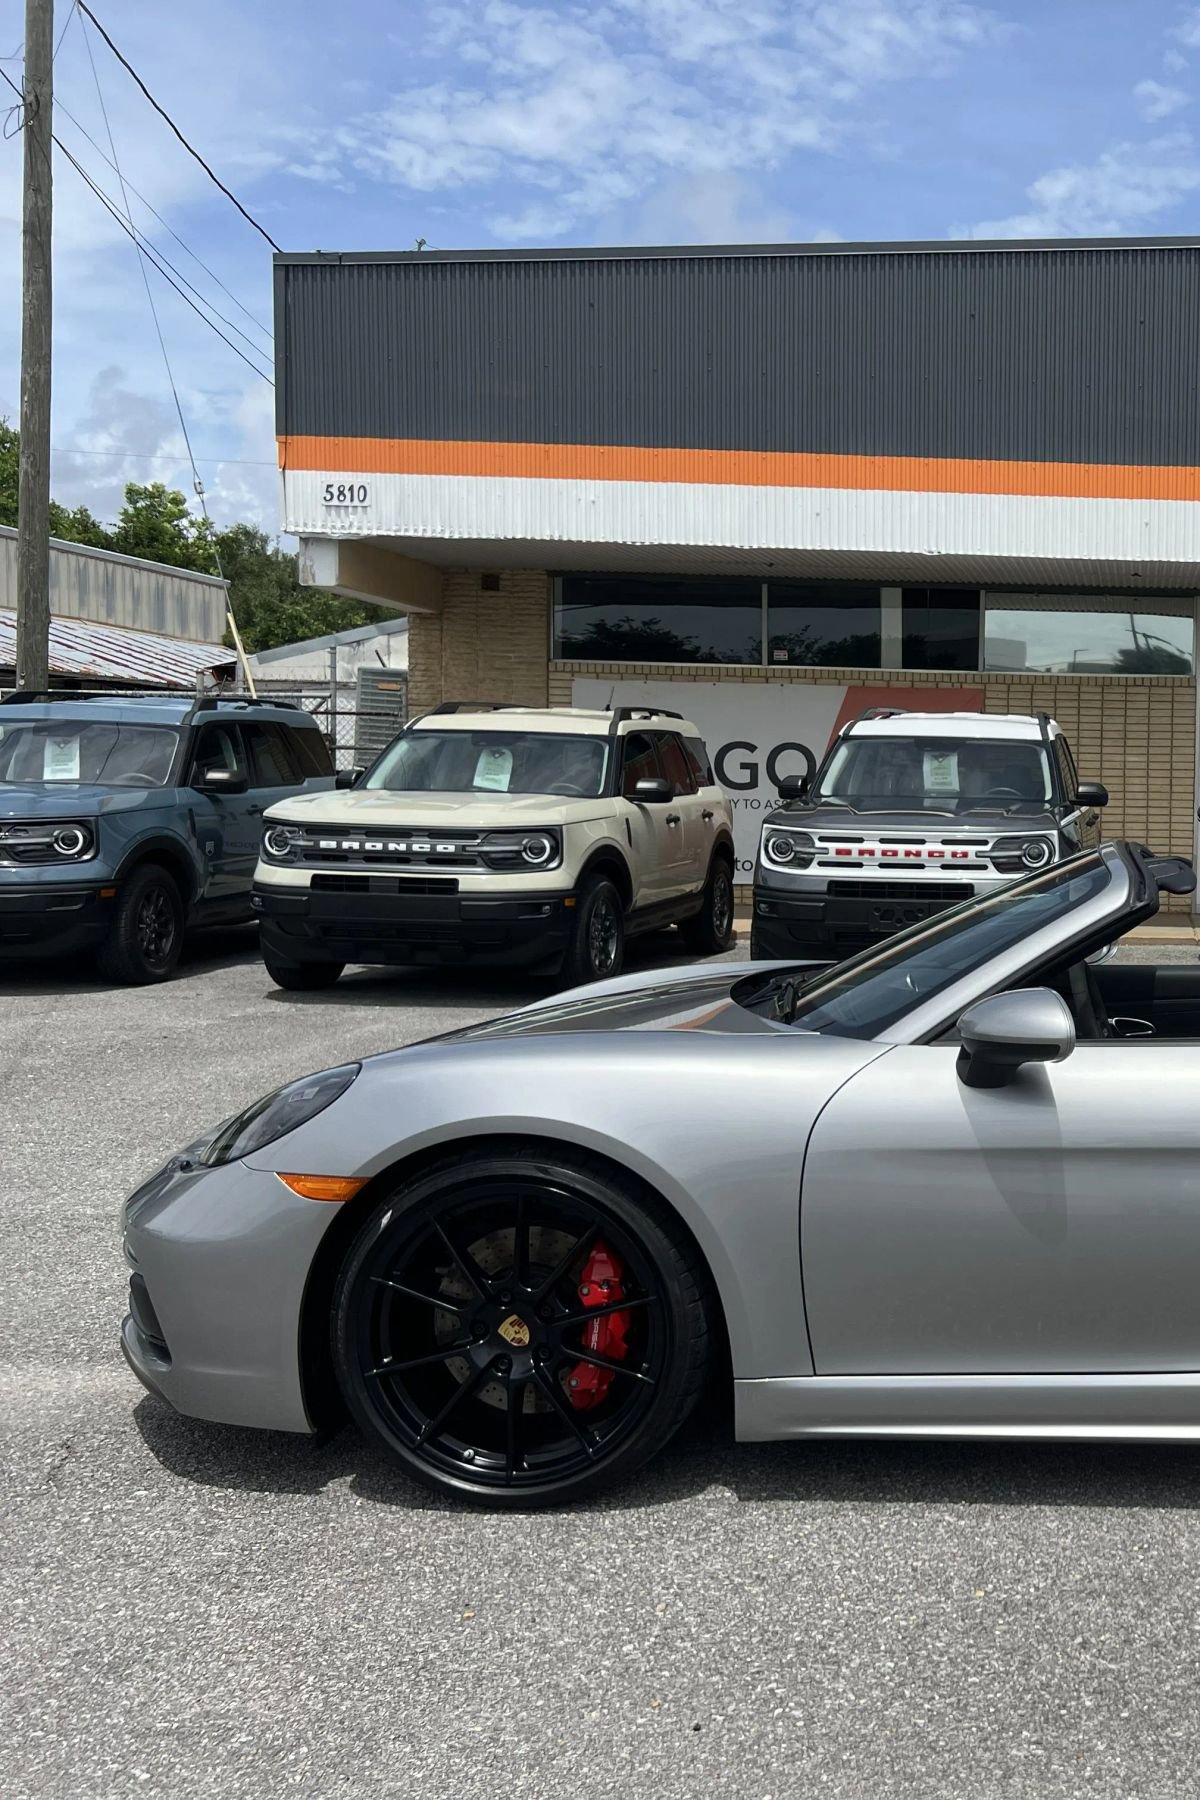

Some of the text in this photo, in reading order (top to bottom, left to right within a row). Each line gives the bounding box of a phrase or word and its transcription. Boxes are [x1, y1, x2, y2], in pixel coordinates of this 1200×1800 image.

[323, 484, 368, 503] 5810
[742, 798, 760, 810] TO
[319, 840, 455, 852] BRONCO
[835, 848, 969, 859] BRONCO
